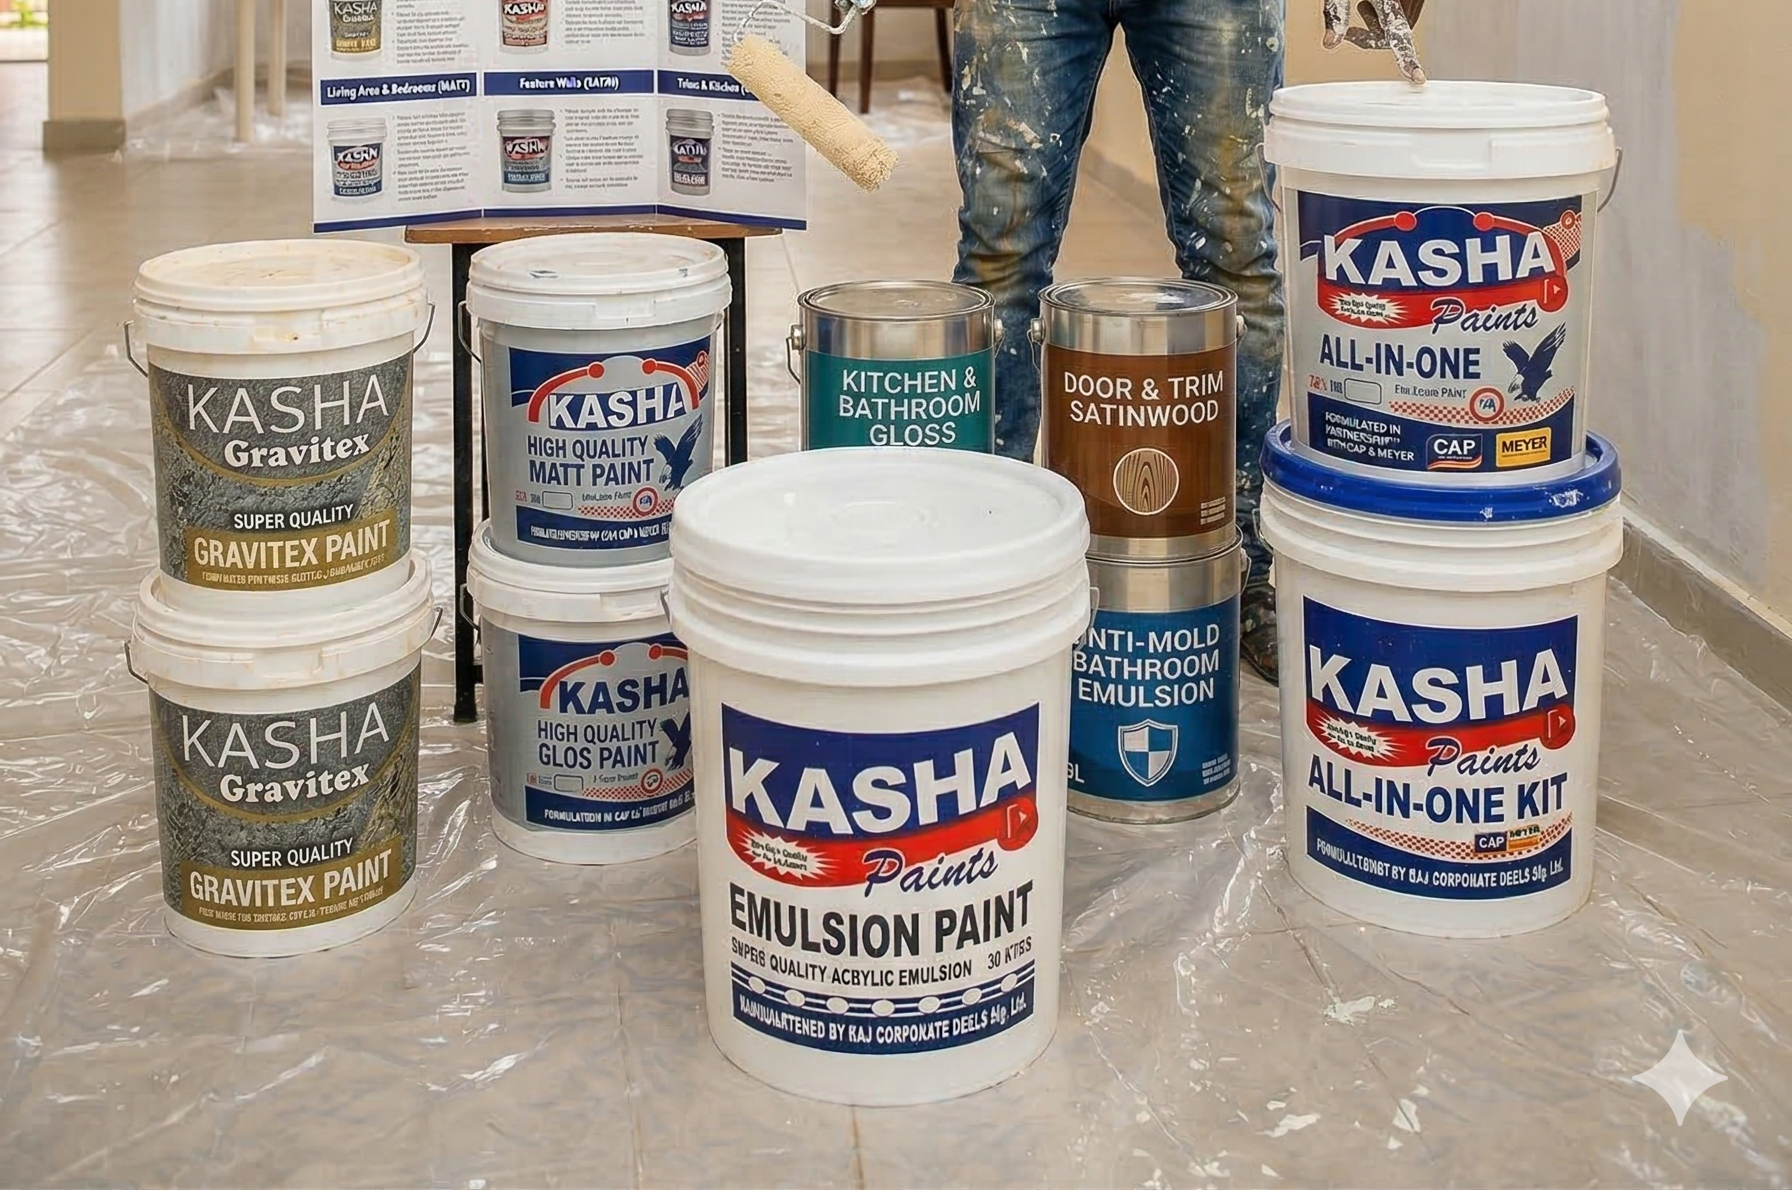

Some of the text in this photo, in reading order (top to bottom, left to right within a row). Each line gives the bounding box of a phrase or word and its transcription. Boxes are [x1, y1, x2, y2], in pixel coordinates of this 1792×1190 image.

[1323, 231, 1556, 287] KASHA
[1431, 297, 1539, 335] Paints
[1319, 334, 1481, 380] ALL-IN-ONE
[842, 366, 977, 393] KITCHEN &
[1064, 370, 1223, 400] DOOR & TRIM
[187, 374, 389, 434] KASHA
[549, 383, 684, 429] KASHA
[839, 390, 981, 420] BATHROOM
[1070, 400, 1218, 427] SATINWOOD
[870, 421, 957, 446] GLOSS
[1389, 424, 1401, 435] IN
[1501, 435, 1547, 453] MEYER
[224, 433, 370, 468] Gravitex
[527, 435, 648, 462] HIGH QUALITY
[1377, 448, 1414, 461] MEYER
[1433, 438, 1476, 455] CAP
[530, 458, 654, 487] MATT PAINT
[230, 503, 354, 530] SUPER QUALITY
[194, 536, 319, 569] GRAVITEX
[326, 519, 391, 563] PAINT
[1075, 624, 1220, 653] NTI-MOLD
[1073, 649, 1219, 680] BATHROOM
[559, 667, 689, 714] KASHA
[1078, 678, 1214, 707] EMULSION
[1309, 644, 1568, 724] KASHA
[182, 702, 389, 769] KASHA
[537, 717, 658, 744] HIGH QUALITY
[538, 740, 659, 770] GLOS PAINT
[1426, 737, 1541, 776] Paints
[220, 763, 370, 803] Gravitex
[729, 731, 1032, 835] KASHA
[1308, 753, 1568, 824] ALL-IN-ONE KIT
[230, 837, 354, 867] SUPER QUALITY
[1479, 836, 1504, 849] CAP
[190, 870, 316, 907] GRAVITEX
[323, 848, 391, 900] PAINT
[863, 846, 998, 898] Paints
[1500, 867, 1530, 886] DEELS
[729, 878, 1034, 959] EMULSION PAINT
[770, 954, 827, 983] QUALITY
[898, 959, 972, 986] EMULSION
[987, 951, 1001, 970] 30
[829, 1022, 845, 1042] BY
